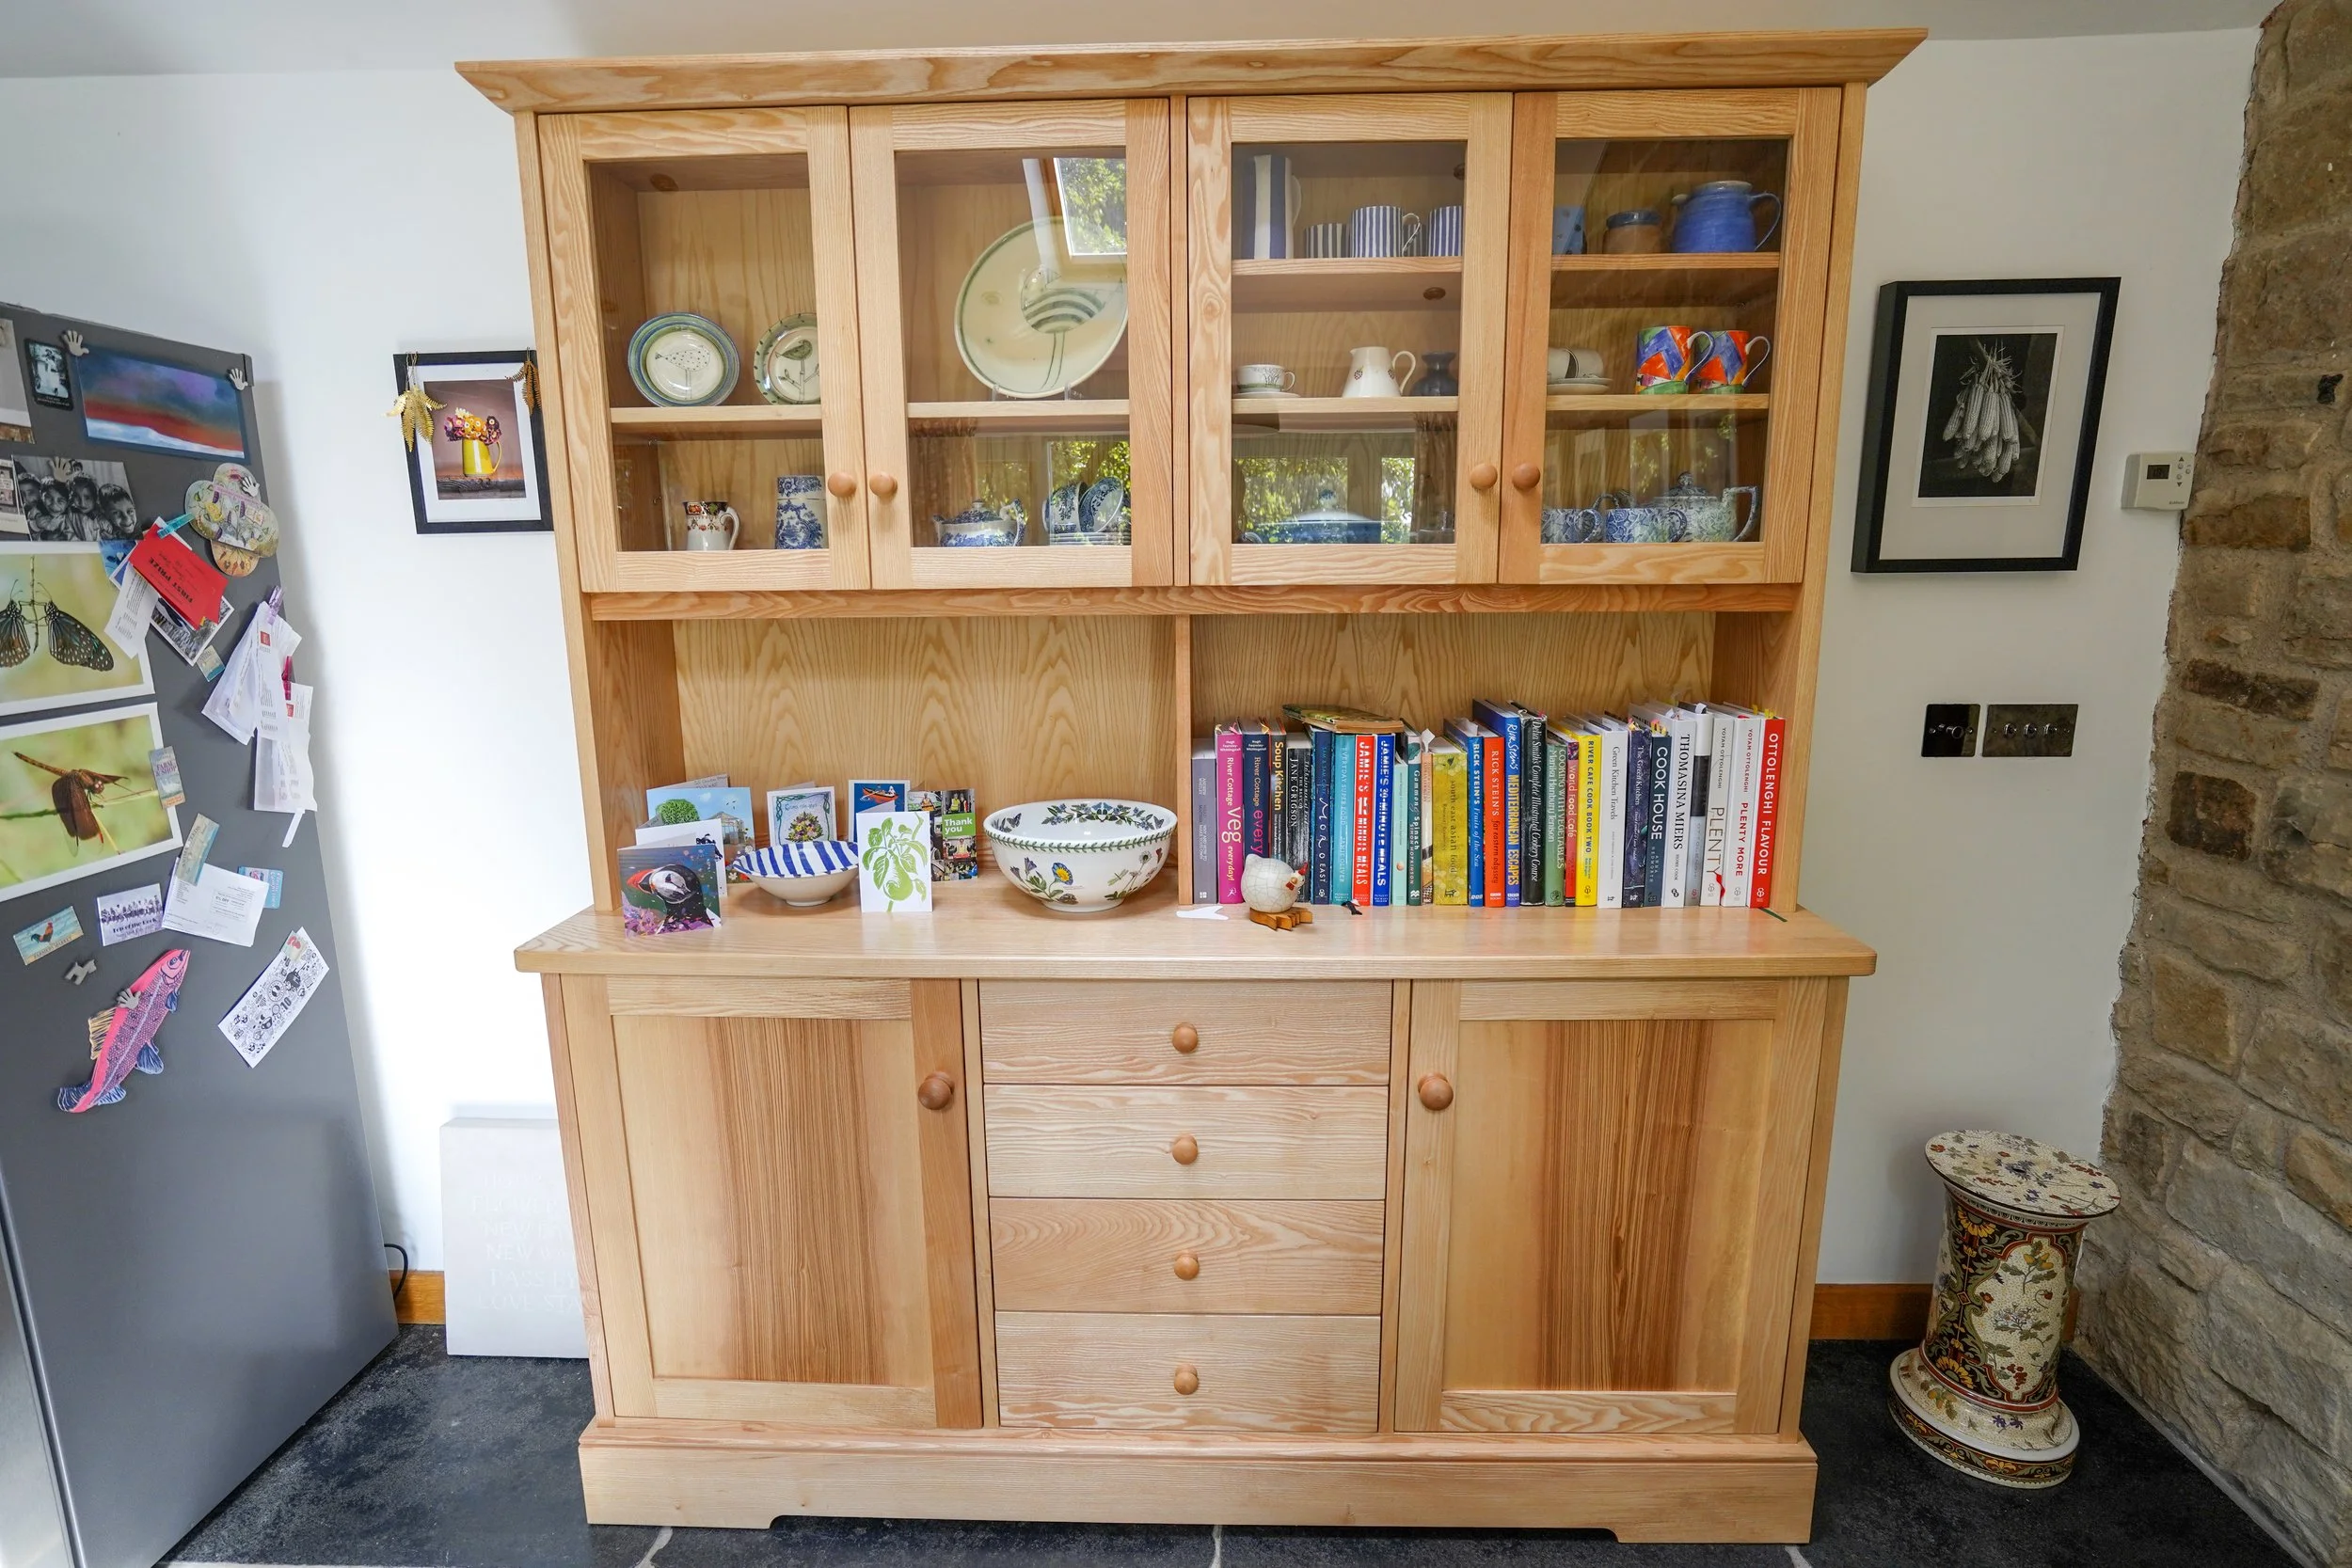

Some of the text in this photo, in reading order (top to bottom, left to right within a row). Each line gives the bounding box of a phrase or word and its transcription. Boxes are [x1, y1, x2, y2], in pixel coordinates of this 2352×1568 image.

[149, 557, 171, 581] PRIZE
[171, 582, 194, 603] FIRST
[1272, 742, 1283, 768] Soup
[1359, 742, 1370, 792] JAMIE'S
[1380, 740, 1389, 785] JAMIE'S
[1557, 749, 1566, 788] COOKING
[1635, 760, 1644, 780] Green
[1636, 746, 1645, 758] The
[1226, 778, 1234, 806] Cottage
[1274, 770, 1284, 811] Kitchen
[1290, 758, 1298, 827] JANE GRIGSON
[1450, 780, 1458, 803] south
[1547, 750, 1557, 842] Marika Hanbury Tenison
[1568, 765, 1577, 792] World
[1610, 747, 1620, 820] Green Kitchen Travels
[1651, 747, 1668, 840] COOK HOUSE
[1674, 734, 1690, 850] THOMASINA MIERS
[1507, 723, 1519, 885] Rick Stein's MEDITERRANEAN ESCAPES
[1529, 721, 1541, 881] Delia Smith's Complete Illustrated Cookery Course
[1757, 733, 1778, 875] OTTOLENGHI FLAVOUR
[945, 817, 973, 826] Thank
[945, 826, 962, 835] you
[1221, 807, 1242, 843] veg
[1251, 810, 1264, 854] every
[1357, 817, 1368, 851] MINUTE
[1450, 825, 1458, 851] asian
[1473, 831, 1481, 839] of
[1491, 819, 1501, 831] far
[1736, 802, 1748, 877] PLENTY MORE
[1557, 813, 1565, 868] VEGETABLES
[1707, 807, 1724, 876] PLENTY
[1357, 856, 1368, 885] MEALS
[1377, 848, 1387, 886] MEALS
[1450, 854, 1458, 873] food
[1491, 858, 1500, 884] odyssey
